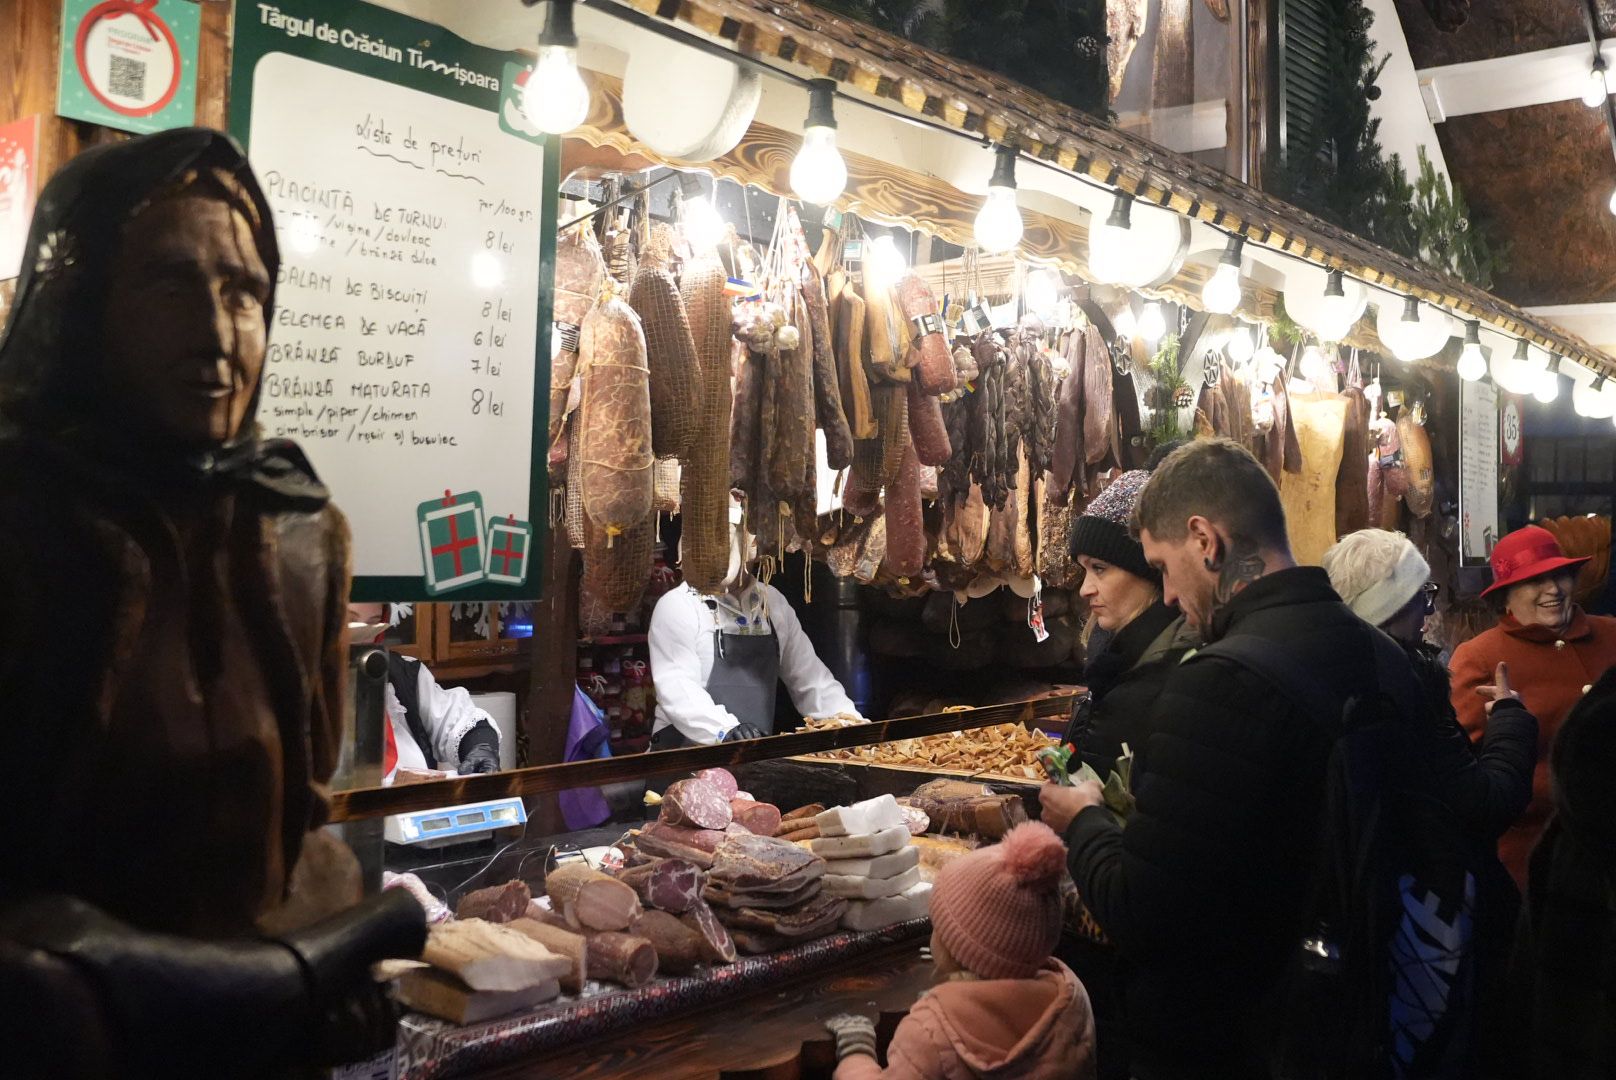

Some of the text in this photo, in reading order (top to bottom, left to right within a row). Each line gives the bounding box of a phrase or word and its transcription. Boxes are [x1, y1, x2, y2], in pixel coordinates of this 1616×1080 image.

[257, 3, 314, 37] Târgul
[315, 23, 338, 44] de
[341, 28, 402, 63] Crăciun
[403, 125, 418, 150] de
[374, 202, 391, 222] DE
[485, 230, 515, 253] 8 lei
[346, 277, 362, 296] DE
[481, 298, 512, 323] 8 lei
[361, 316, 378, 336] DE
[387, 318, 428, 336] VACĂ
[473, 324, 507, 348] 6 lei
[358, 350, 415, 369] BURDUF
[471, 356, 502, 377] 7 lei
[471, 388, 504, 417] 8 lei
[1506, 414, 1517, 441] 35
